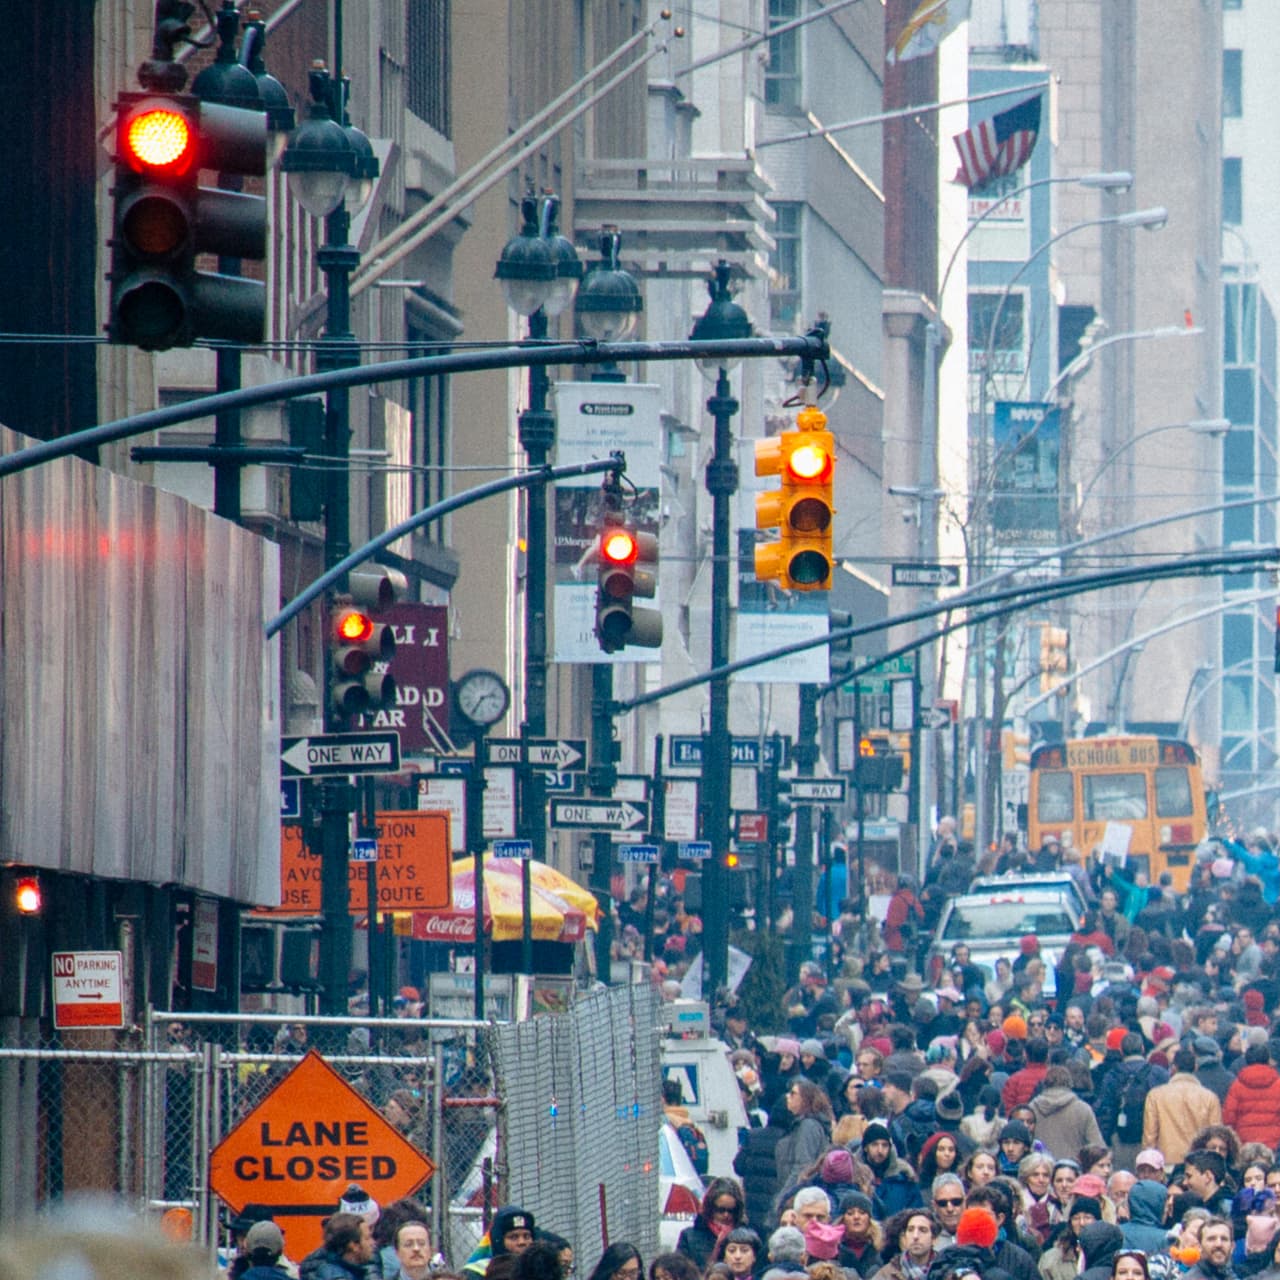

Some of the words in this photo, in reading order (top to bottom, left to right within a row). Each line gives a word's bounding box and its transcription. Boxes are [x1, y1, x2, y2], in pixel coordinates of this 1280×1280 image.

[901, 571, 920, 580] ONE
[930, 571, 950, 580] WAY
[308, 746, 341, 763] ONE
[351, 744, 385, 761] WAY
[498, 746, 520, 760] ON
[540, 748, 570, 762] WAY
[680, 744, 700, 761] Ea
[731, 744, 754, 761] 9th
[1070, 748, 1120, 765] SCHOOL
[1130, 747, 1155, 763] BUS
[812, 787, 835, 796] WAY
[564, 808, 591, 821] ONE
[606, 809, 635, 822] WAY
[348, 864, 417, 881] DEAYS
[54, 955, 74, 975] NO
[77, 960, 116, 971] PARKING
[65, 979, 111, 989] ANYTIME
[261, 1122, 368, 1146] LANE
[234, 1155, 397, 1181] CLOSED
